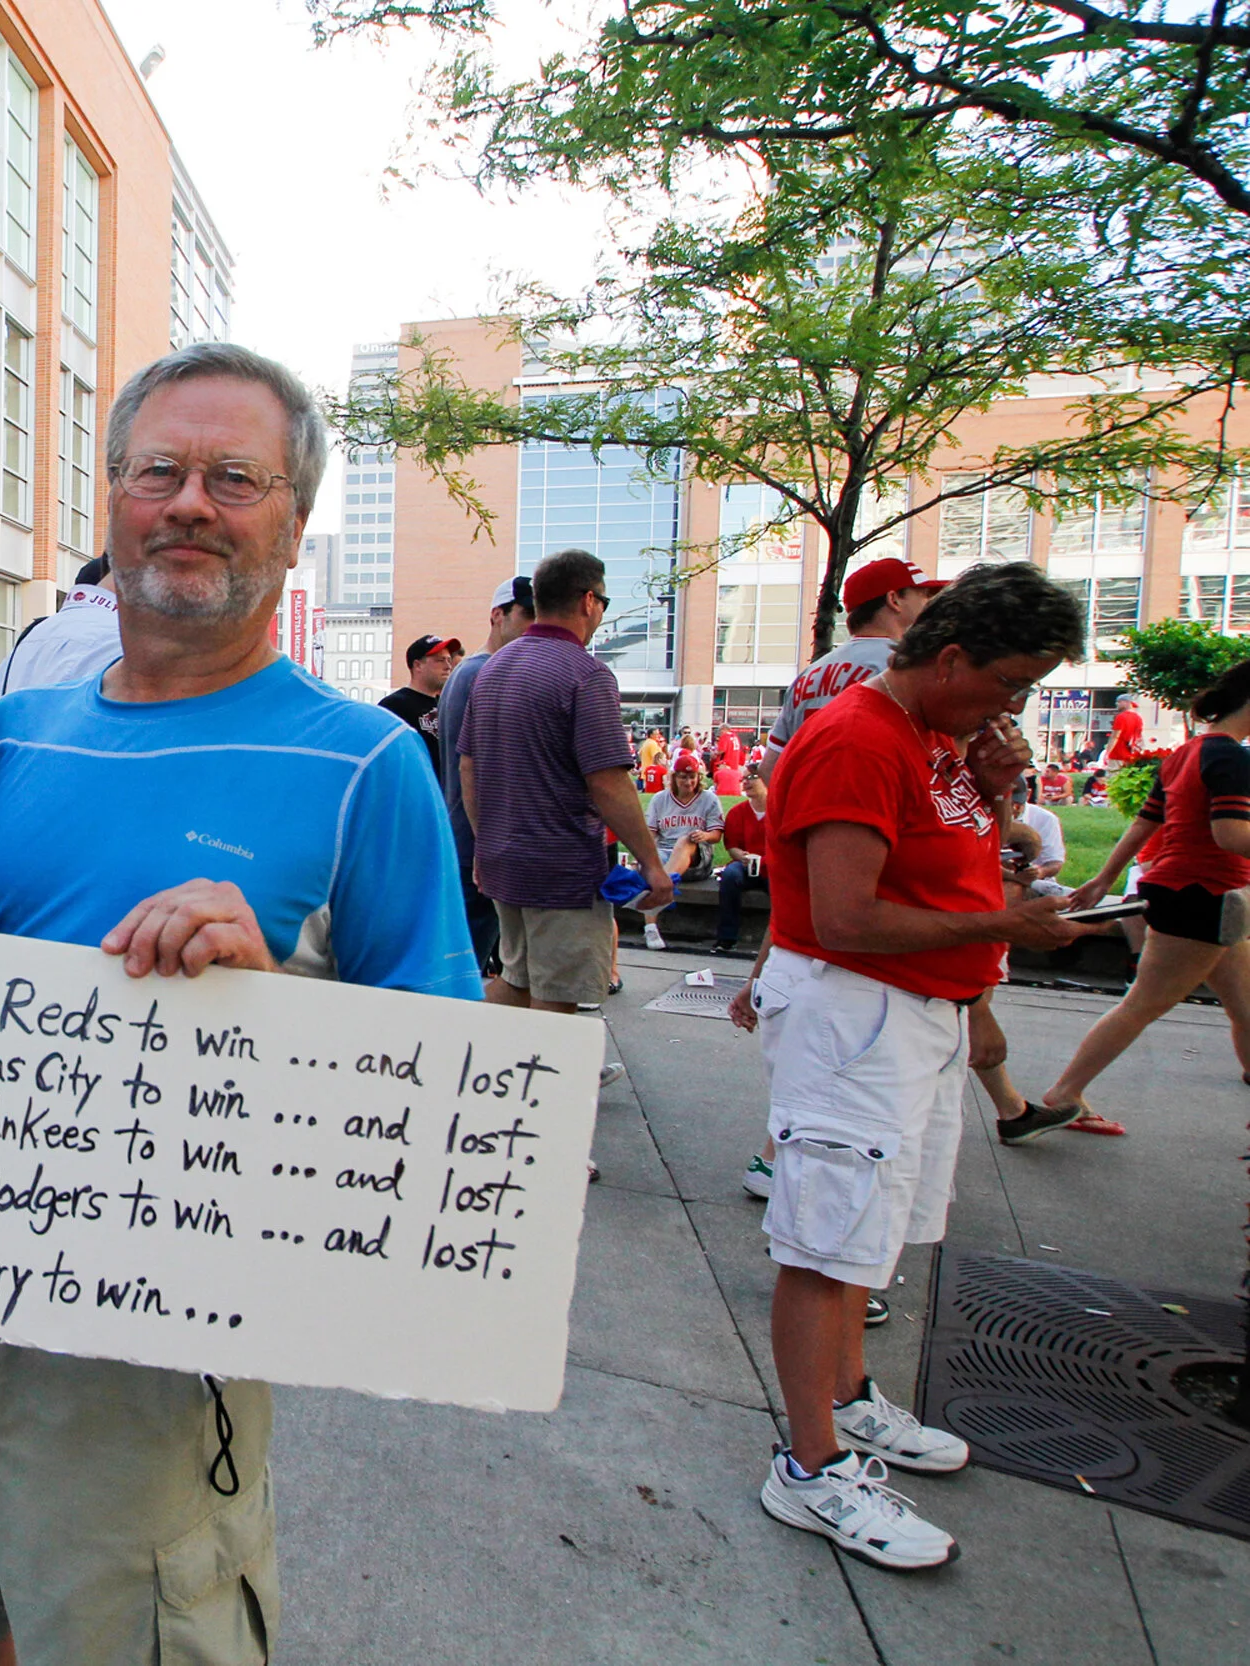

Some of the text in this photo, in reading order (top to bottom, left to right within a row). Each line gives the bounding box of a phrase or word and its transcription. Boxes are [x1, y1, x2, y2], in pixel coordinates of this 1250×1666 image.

[198, 833, 254, 860] Columbia
[0, 978, 121, 1044] Reds
[129, 1000, 167, 1051] to
[196, 1026, 259, 1061] win
[356, 1042, 423, 1086] and
[458, 1042, 559, 1108] lost.
[35, 1052, 102, 1117] City
[123, 1062, 161, 1108] to
[189, 1080, 250, 1119] win
[344, 1107, 410, 1145] and
[446, 1113, 539, 1165] lost.
[114, 1118, 155, 1164] to
[183, 1139, 242, 1175] win
[336, 1158, 405, 1200] and
[440, 1168, 525, 1219] lost.
[42, 1251, 81, 1304] to
[119, 1179, 158, 1229] to
[174, 1199, 233, 1238] win
[324, 1215, 391, 1259] and
[422, 1224, 516, 1279] lost.
